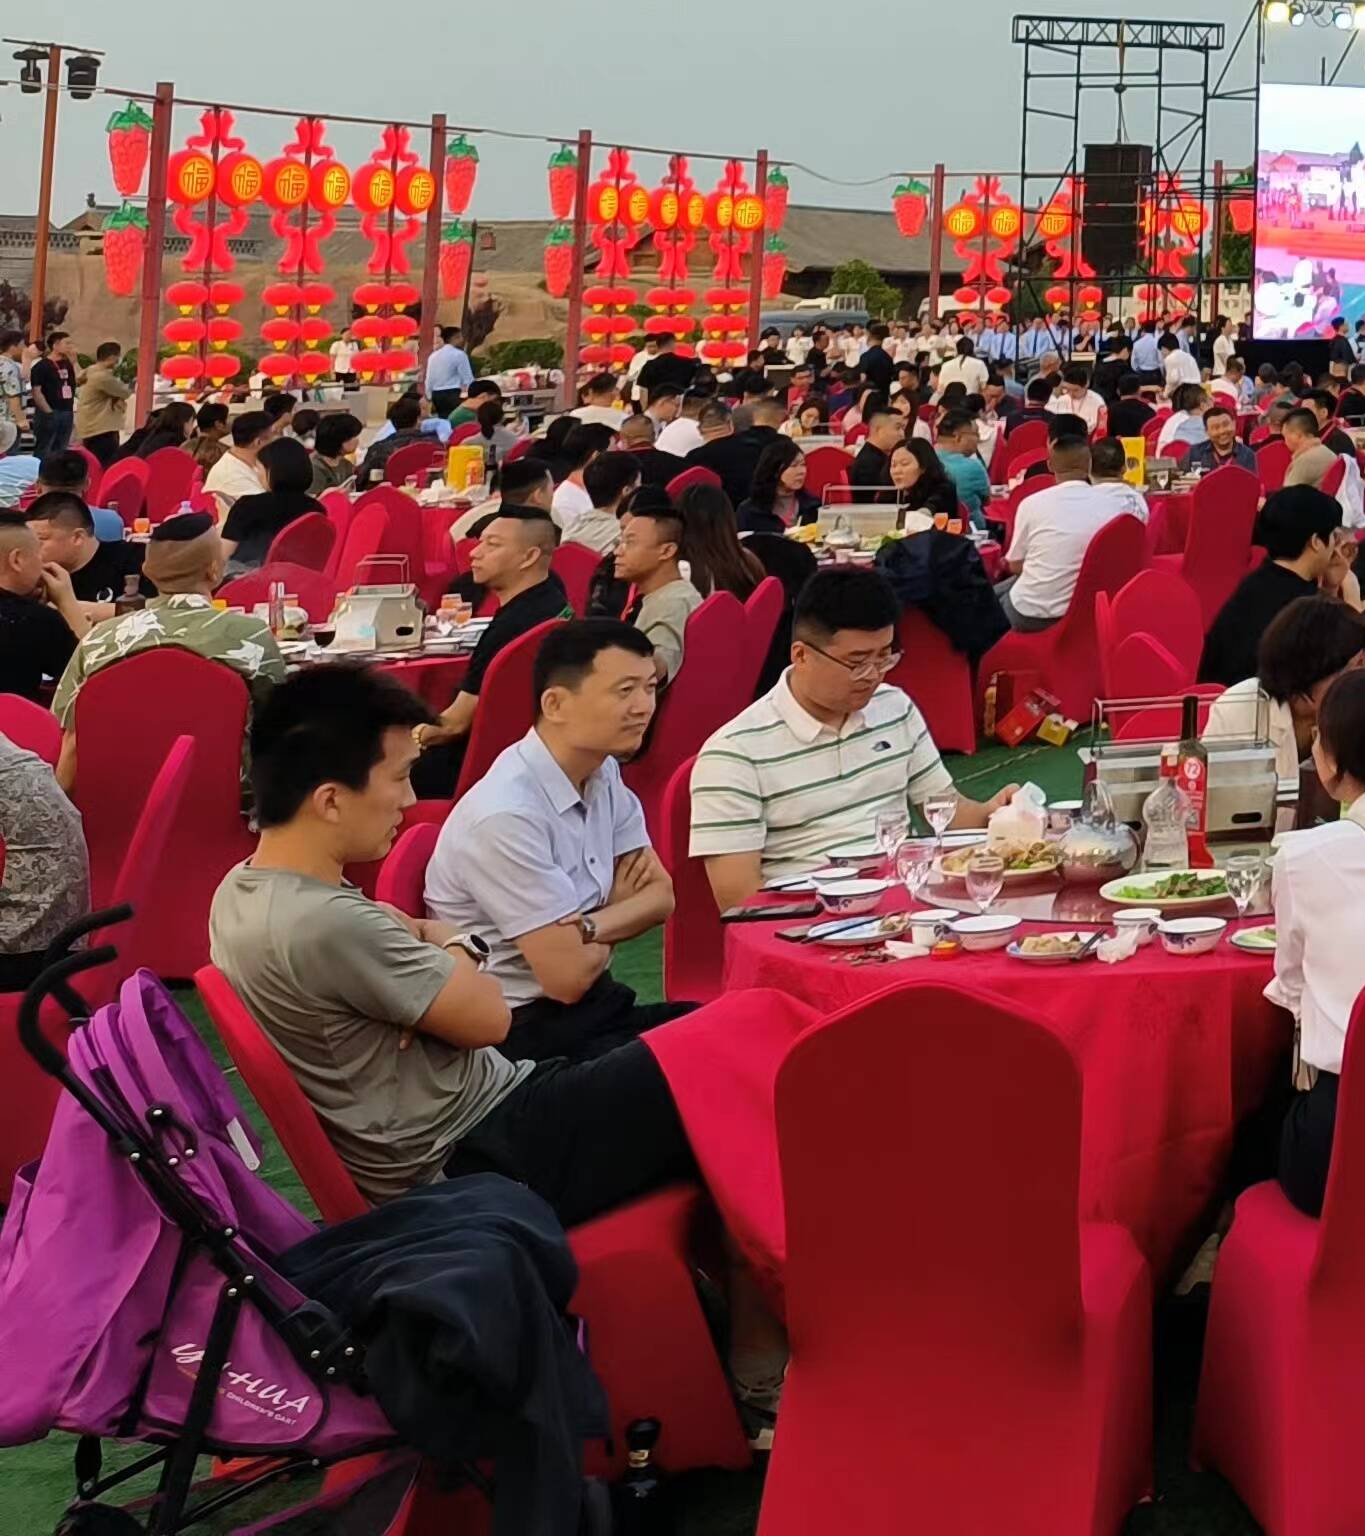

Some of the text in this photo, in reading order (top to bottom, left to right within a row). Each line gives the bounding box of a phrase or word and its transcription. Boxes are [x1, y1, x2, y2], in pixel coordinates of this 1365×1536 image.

[183, 162, 209, 199] 福
[234, 162, 259, 199] 福
[278, 167, 307, 200] 福
[326, 170, 346, 203] 福
[372, 172, 391, 205] 福
[410, 175, 431, 206] 福
[736, 201, 760, 225] 福
[1186, 761, 1200, 776] 72
[274, 1413, 297, 1425] CART
